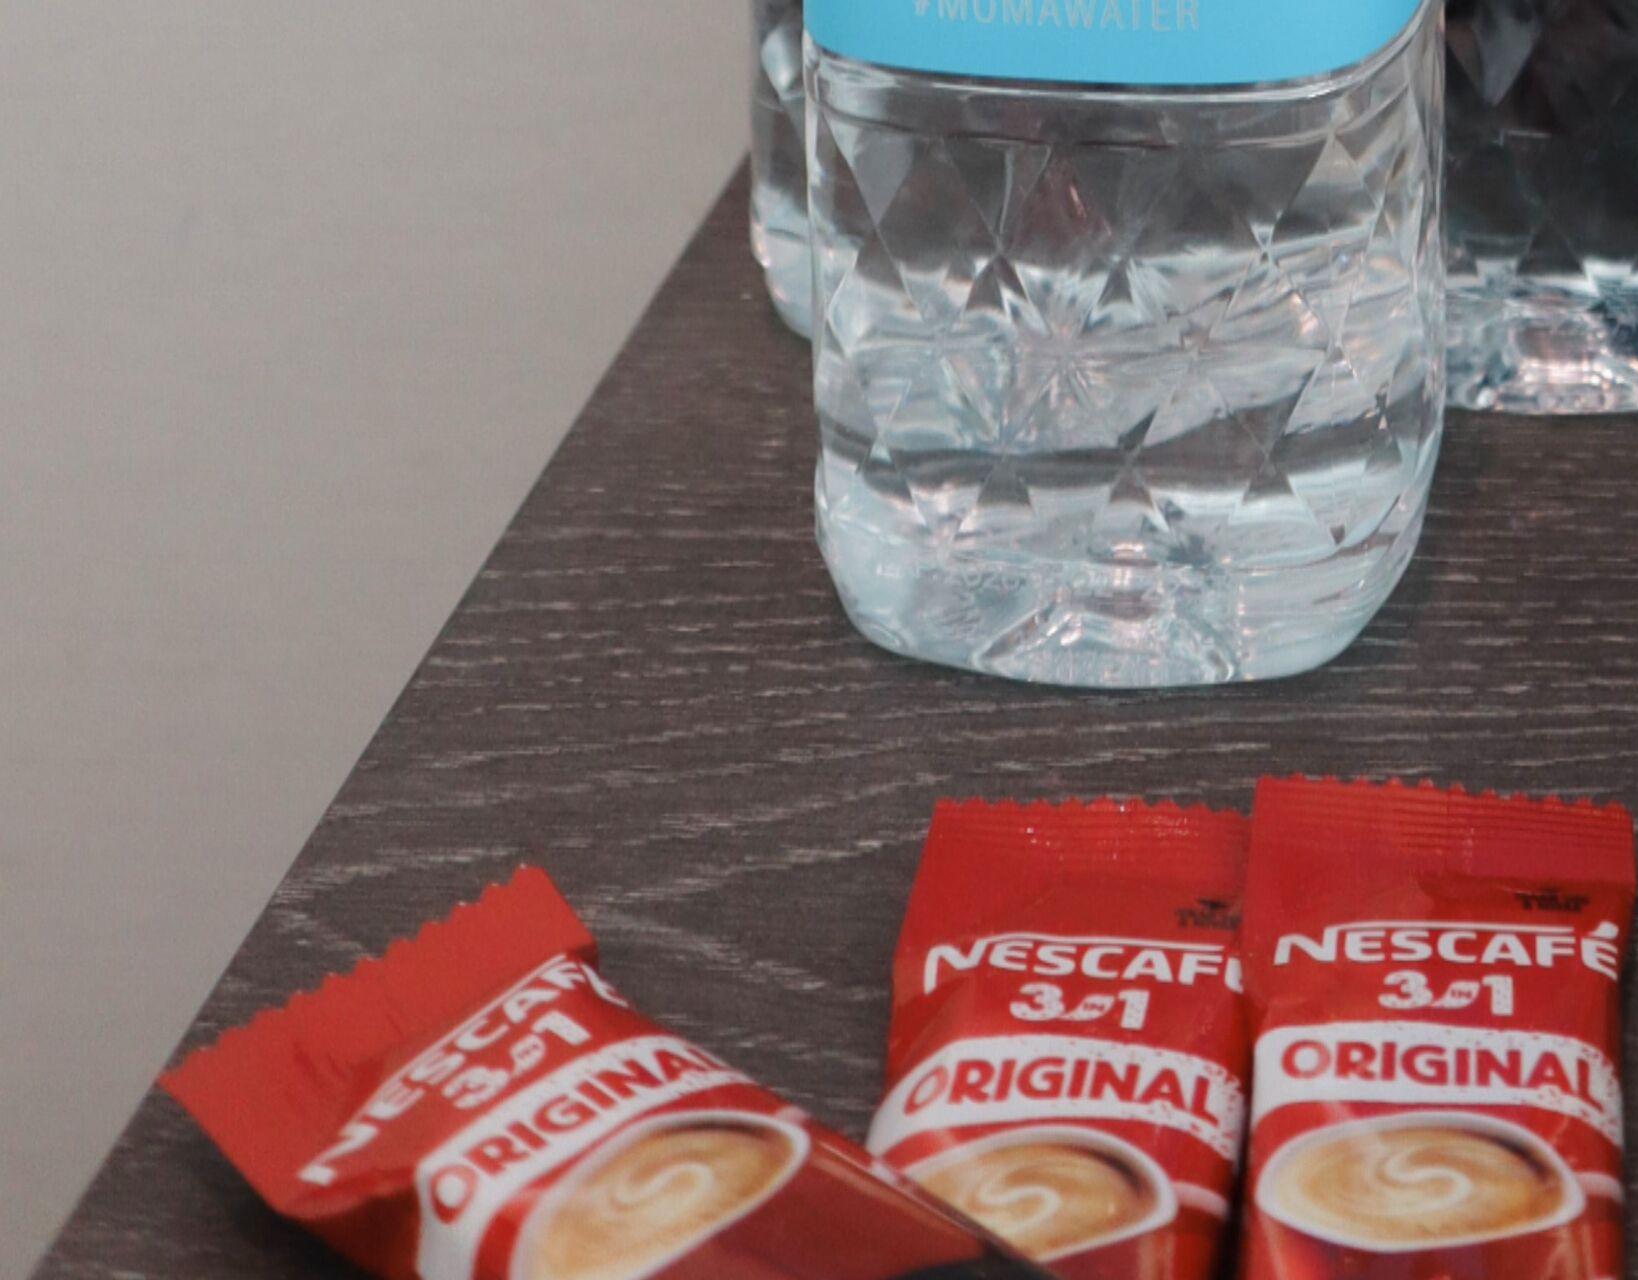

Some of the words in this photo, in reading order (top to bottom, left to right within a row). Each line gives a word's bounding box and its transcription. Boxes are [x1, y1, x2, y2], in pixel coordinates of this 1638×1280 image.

[1273, 920, 1620, 982] NESCAFÉ
[903, 1055, 1220, 1128] ORIGINAL
[1280, 1039, 1605, 1114] ORIGINAL
